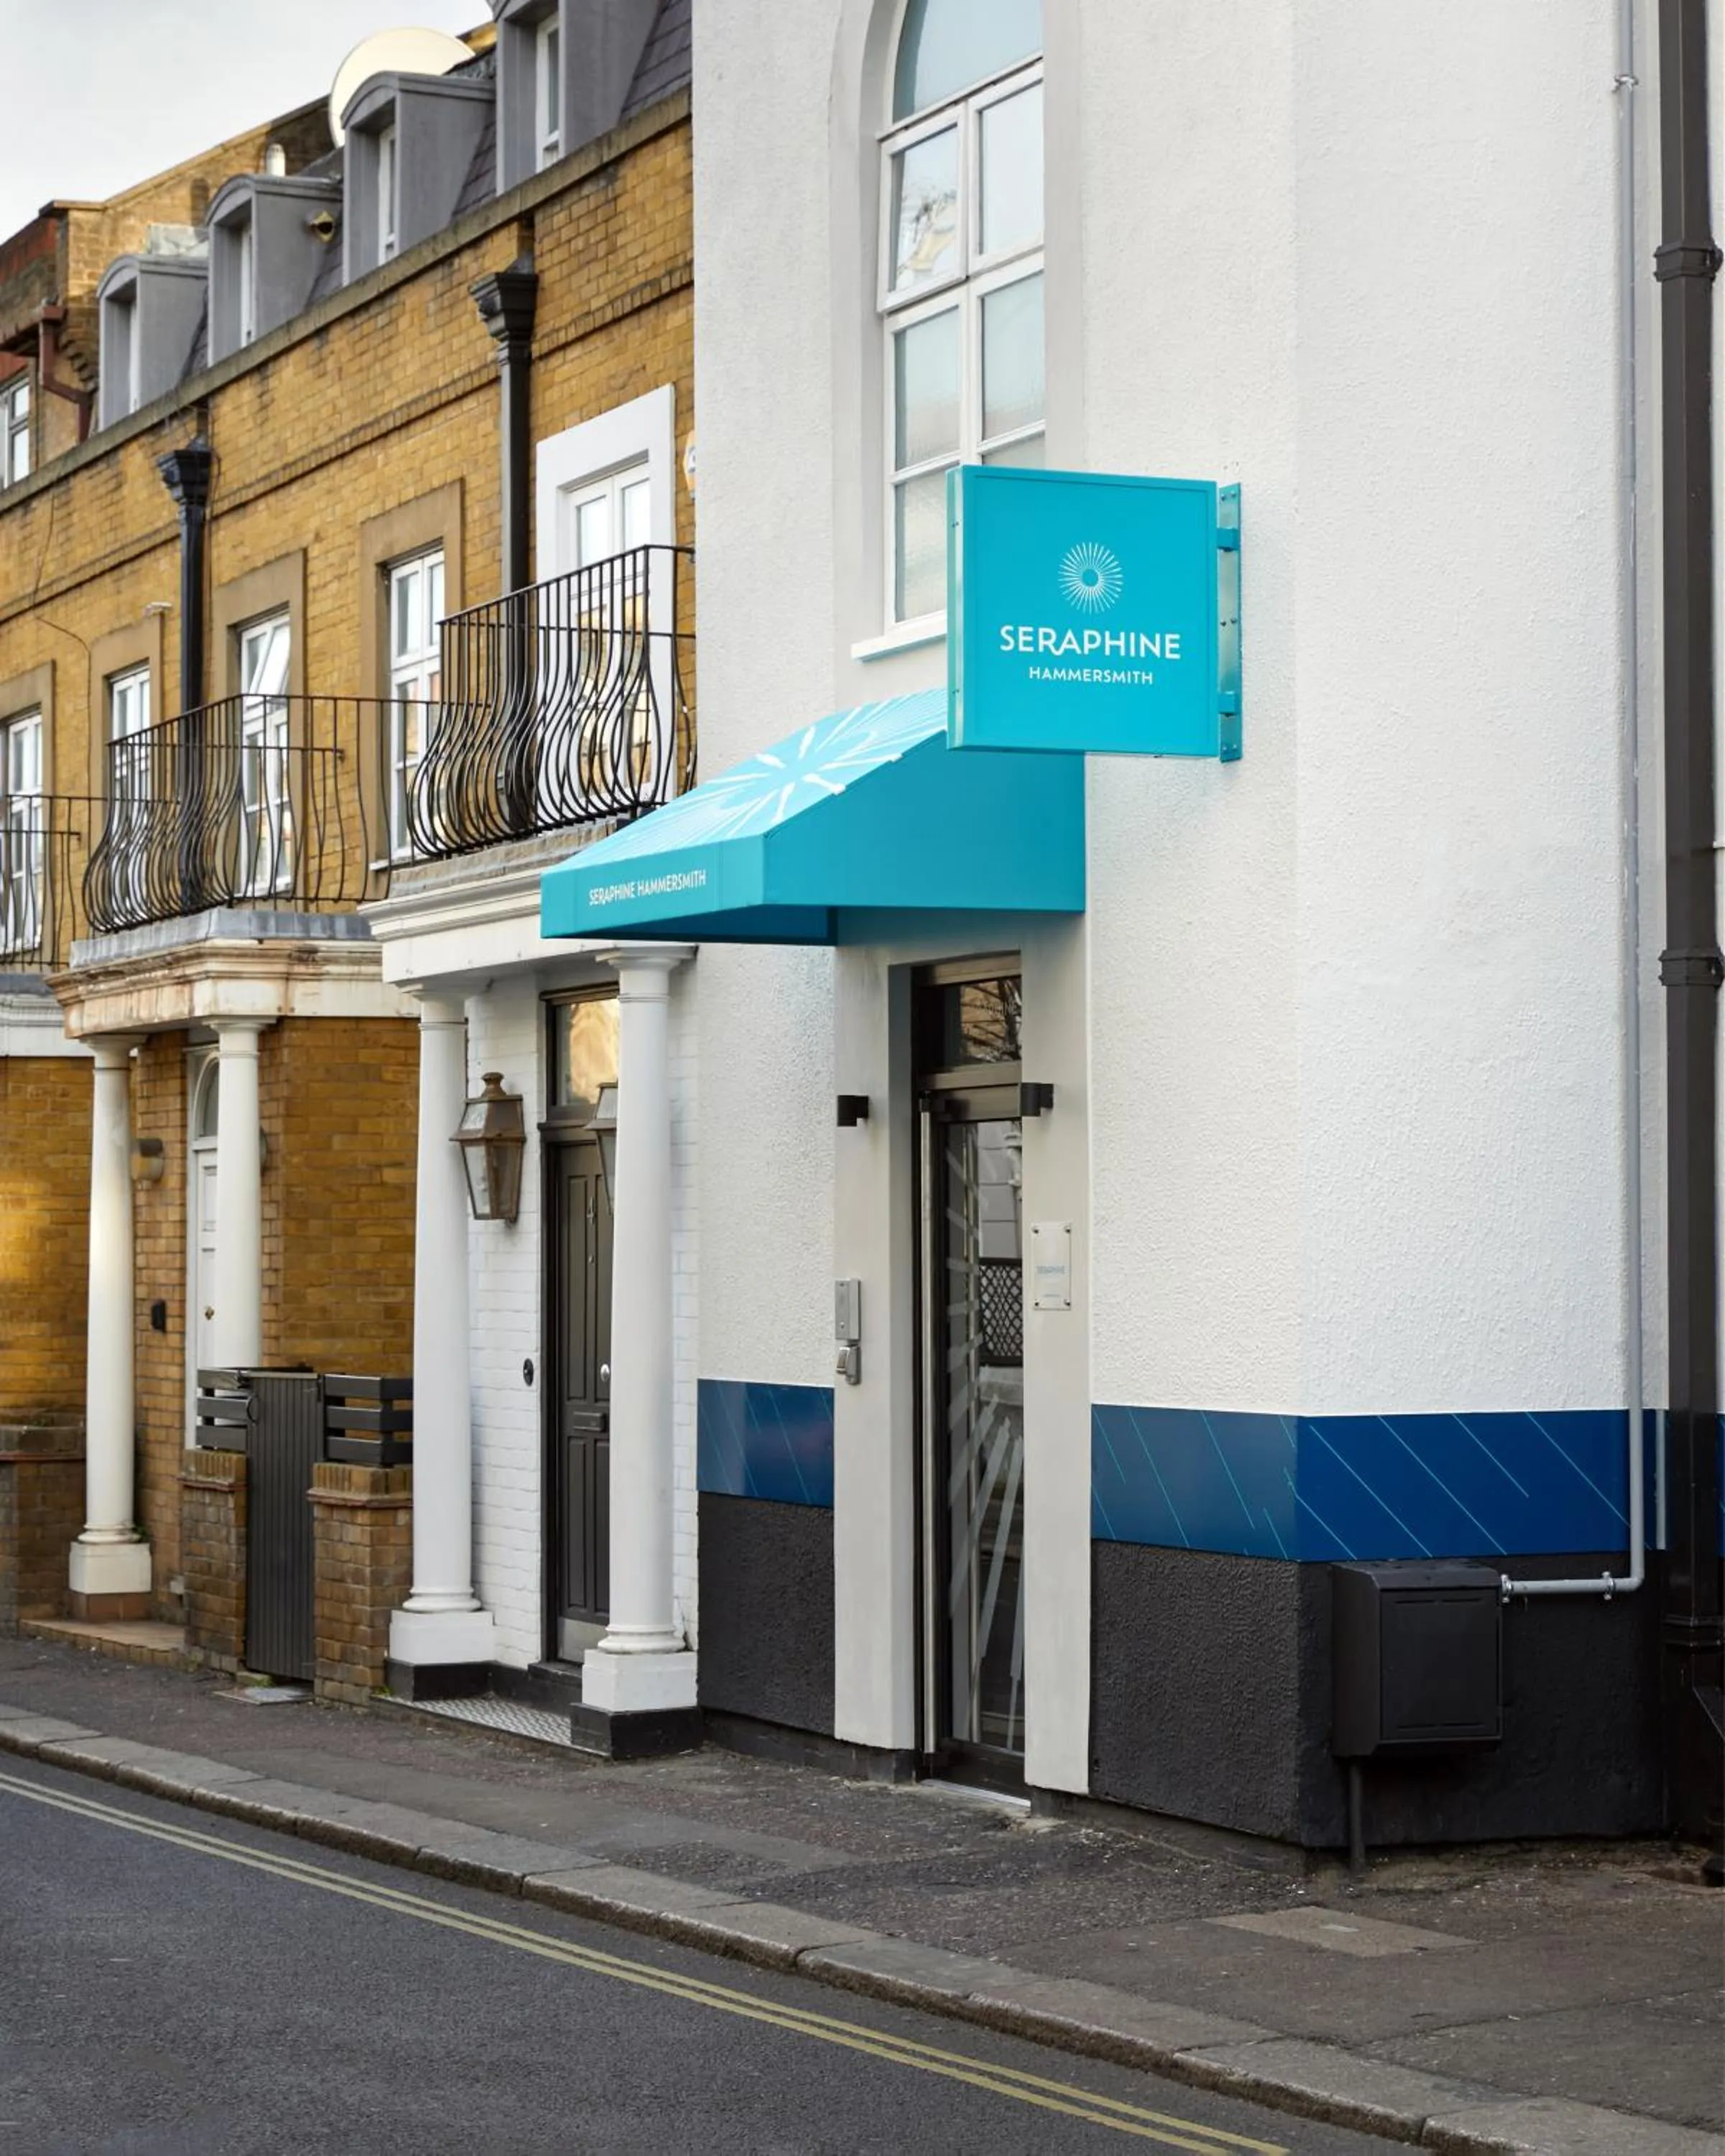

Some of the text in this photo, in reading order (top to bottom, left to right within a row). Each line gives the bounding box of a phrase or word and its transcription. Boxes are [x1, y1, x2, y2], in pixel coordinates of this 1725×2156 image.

[1000, 625, 1181, 659] SERAPHINE
[1029, 666, 1153, 684] HAMMERSMITH
[589, 870, 707, 906] SERAPHINE HAMMERSMITH
[586, 1195, 594, 1225] 4
